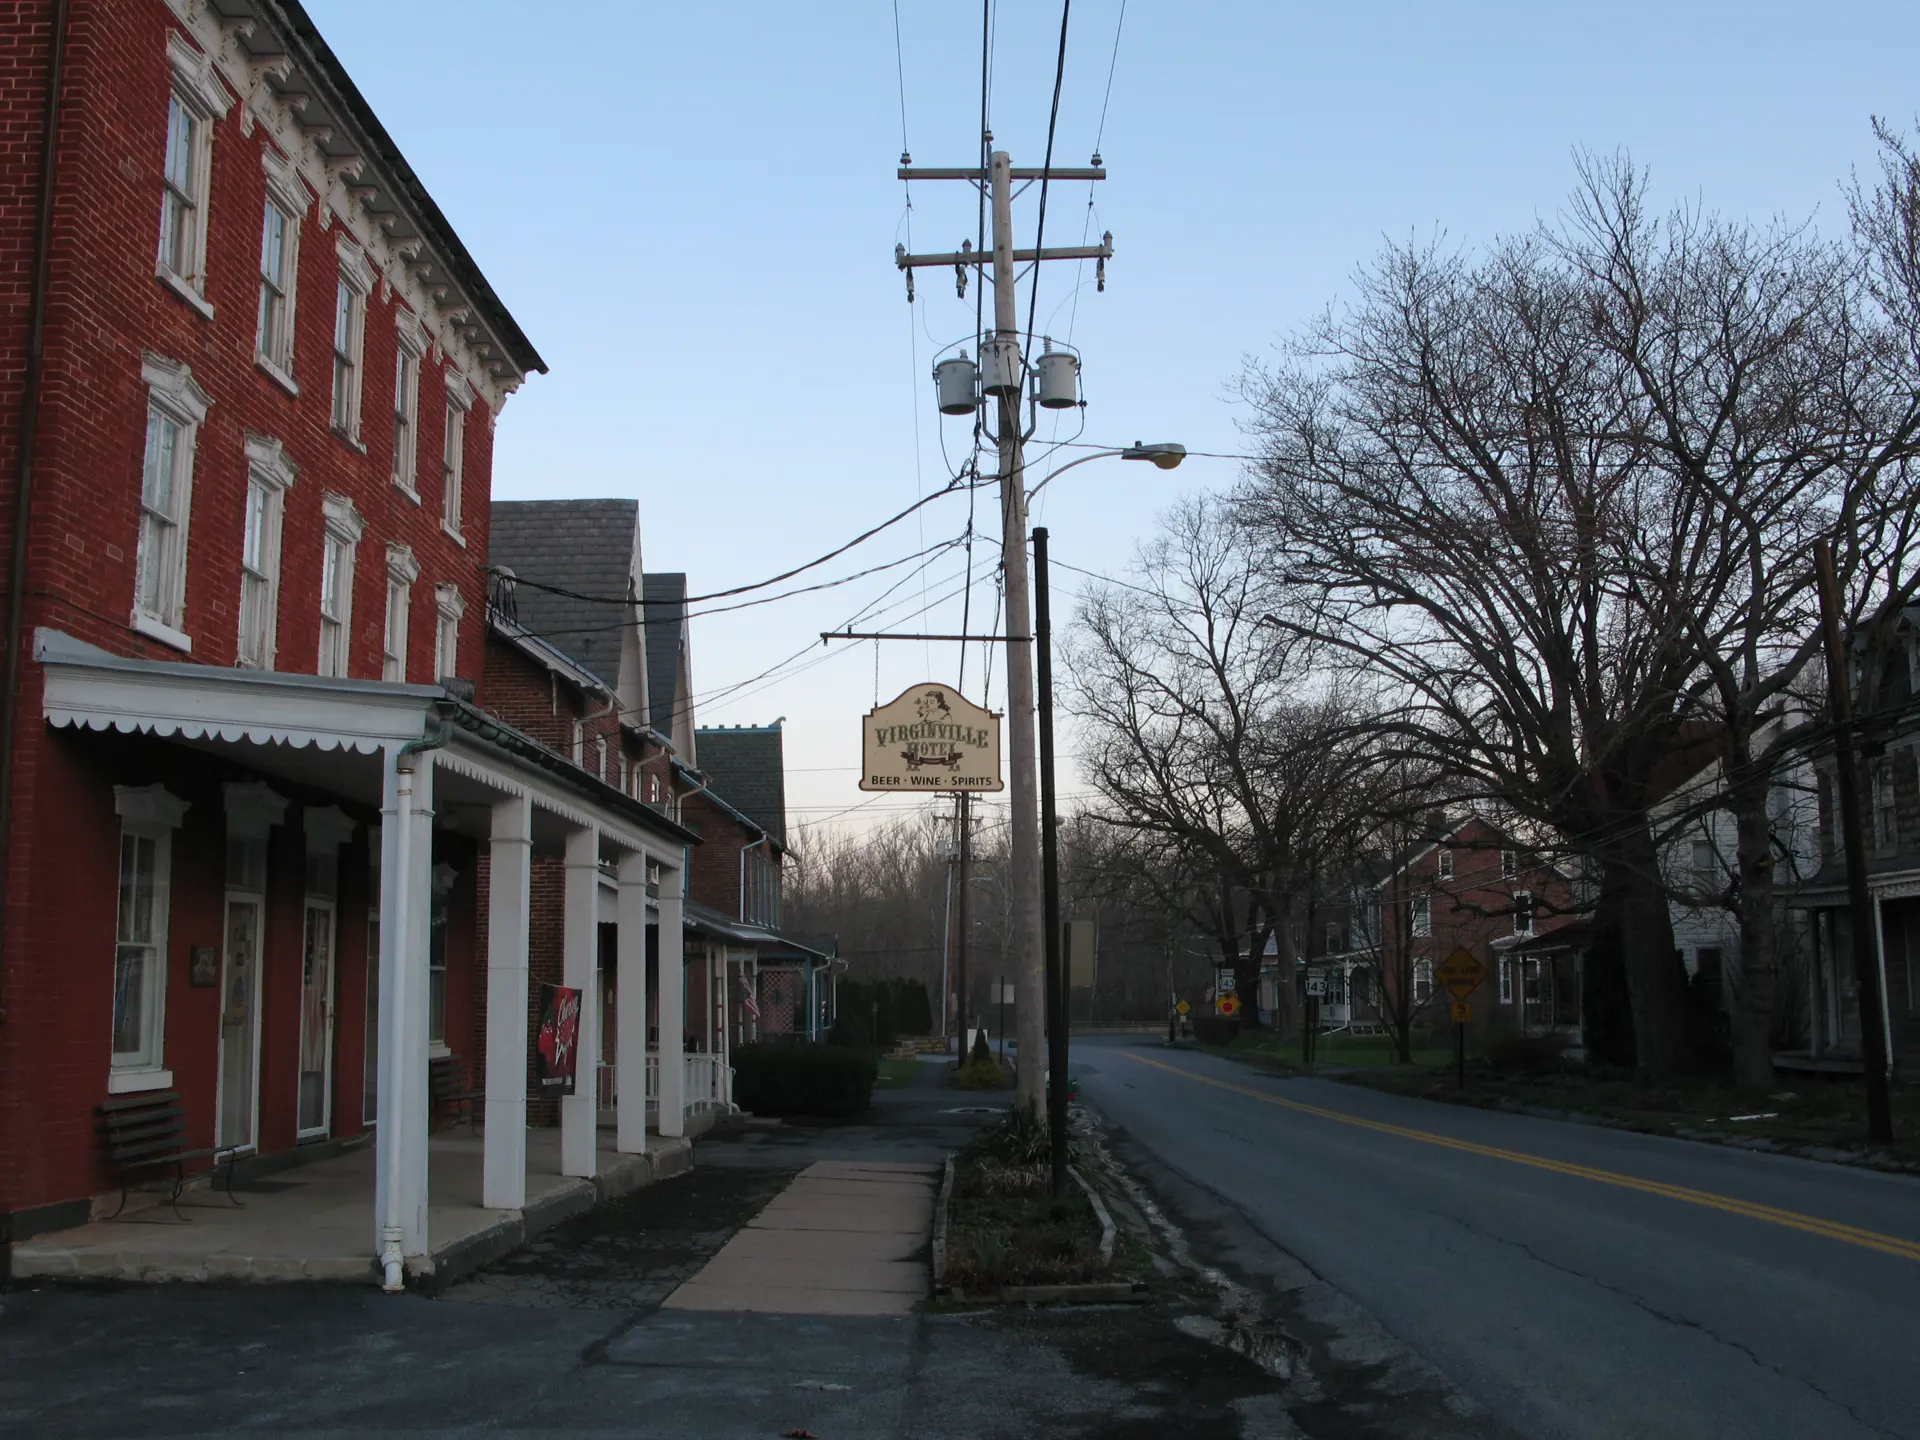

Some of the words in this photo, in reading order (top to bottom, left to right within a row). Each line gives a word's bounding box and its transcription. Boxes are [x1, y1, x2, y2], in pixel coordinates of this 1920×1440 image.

[875, 723, 989, 748] VIRGINVILLE
[905, 741, 959, 770] HOTEL
[871, 775, 901, 786] BEER
[910, 775, 941, 786] WINE
[951, 775, 992, 786] SPIRITS
[1220, 979, 1235, 988] 143
[1307, 981, 1326, 992] 143
